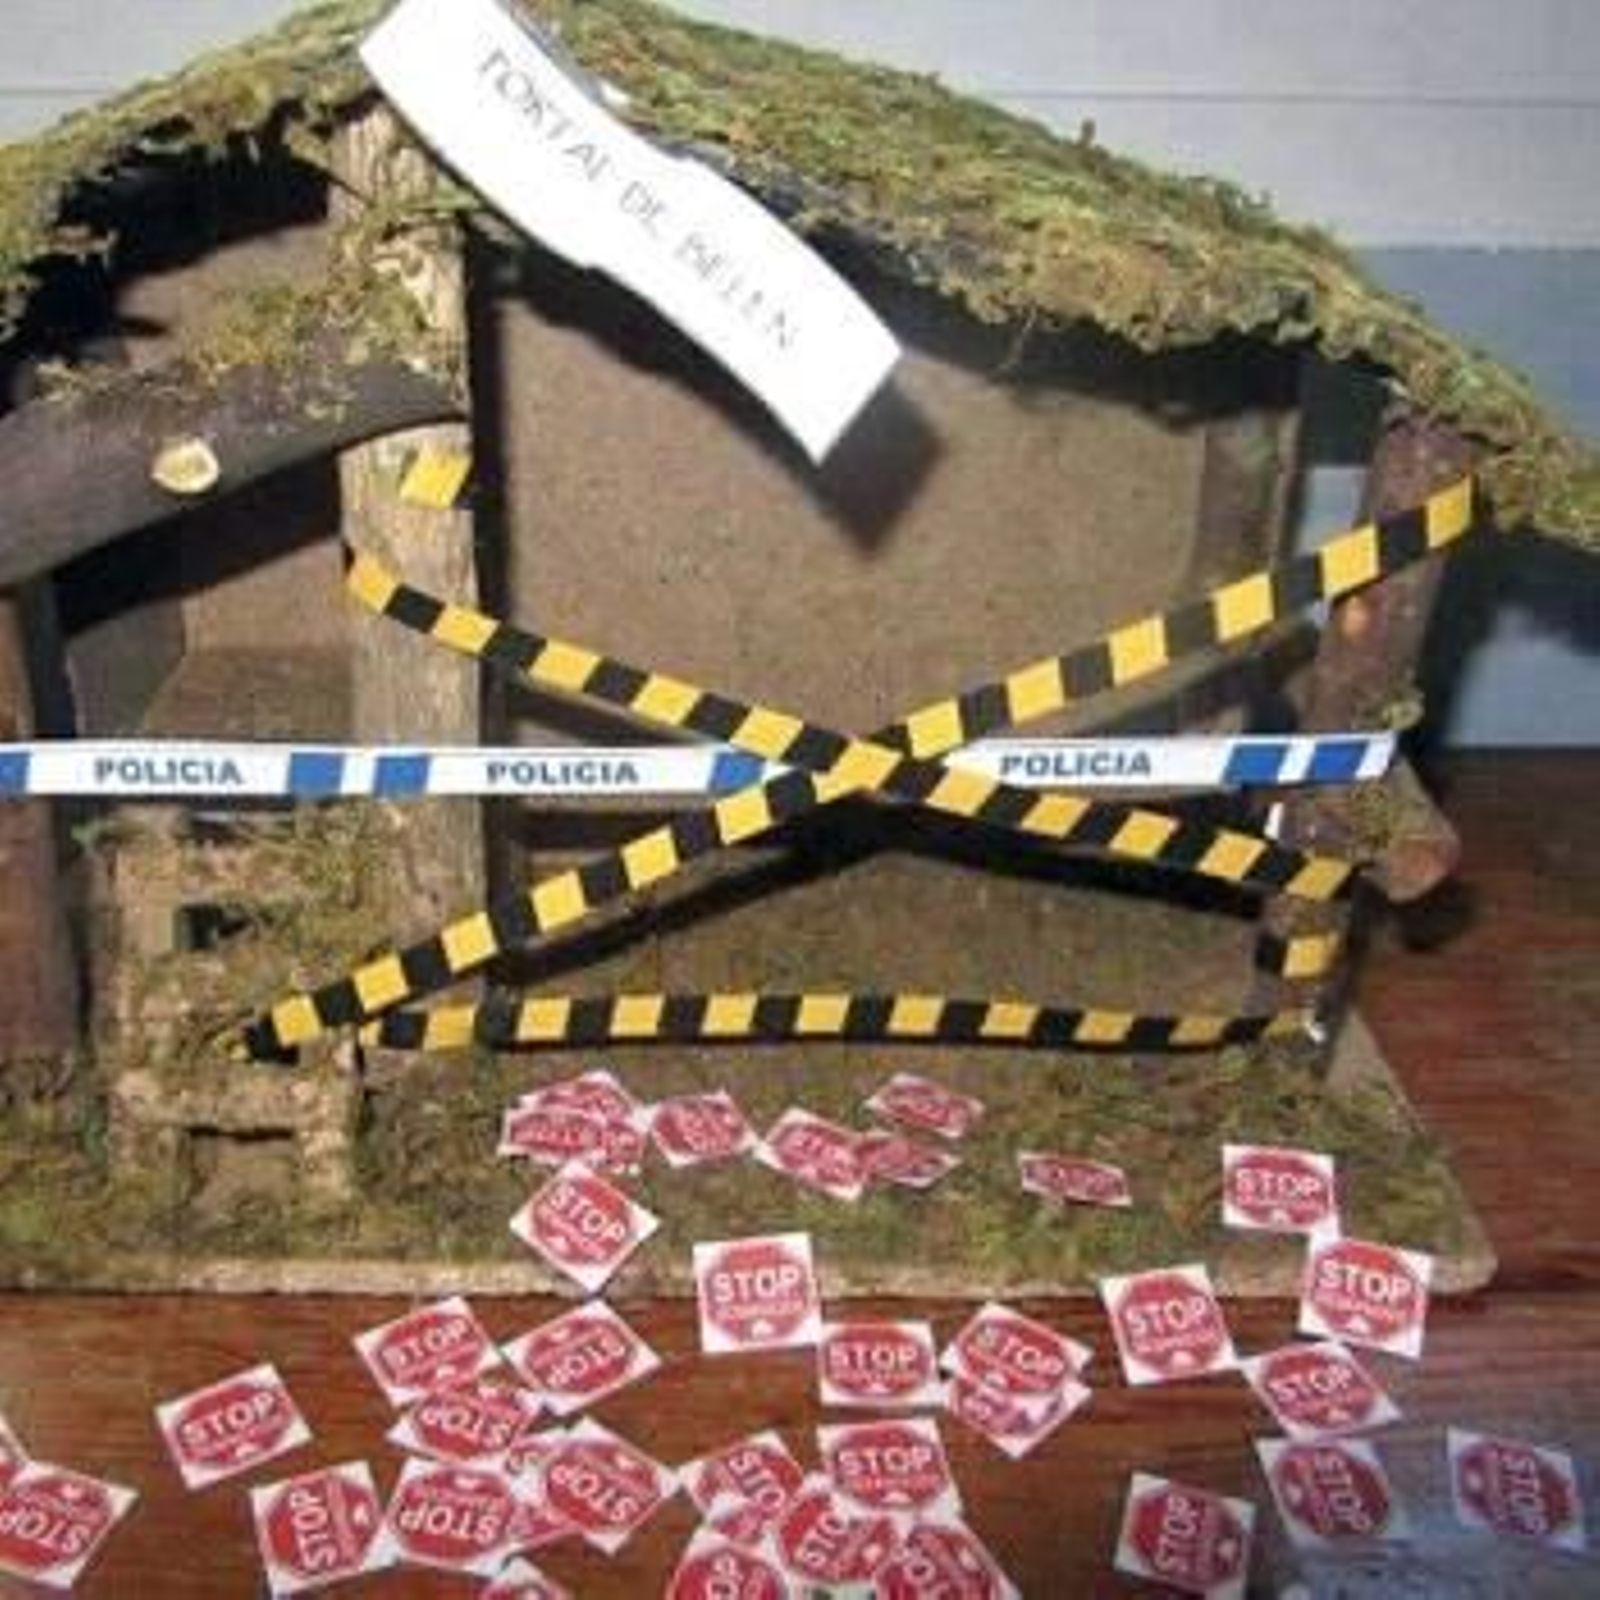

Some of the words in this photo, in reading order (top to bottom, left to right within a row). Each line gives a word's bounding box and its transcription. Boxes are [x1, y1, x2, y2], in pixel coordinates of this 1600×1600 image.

[619, 180, 666, 244] DE
[94, 755, 243, 786] POLICIA
[486, 758, 640, 786] POLICIA
[1001, 751, 1152, 777] POLICIA
[1236, 1167, 1322, 1197] STOP
[551, 1184, 626, 1242] STOP
[713, 1264, 800, 1301] STOP
[1318, 1258, 1413, 1306] STOP
[1124, 1298, 1208, 1336] STOP
[828, 1342, 918, 1374] STOP
[973, 1327, 1064, 1374] STOP
[1269, 1366, 1354, 1405] STOP
[181, 1391, 277, 1444] STOP
[420, 1408, 511, 1446] STOP
[729, 1452, 786, 1511] STO
[838, 1447, 932, 1477] STOP
[550, 1464, 640, 1521] STOP
[1315, 1449, 1373, 1532] STOP
[1502, 1456, 1547, 1534] STOP
[290, 1490, 338, 1570] STOP
[400, 1502, 501, 1545] STOP
[802, 1510, 846, 1567] STO
[1155, 1496, 1200, 1574] STOP
